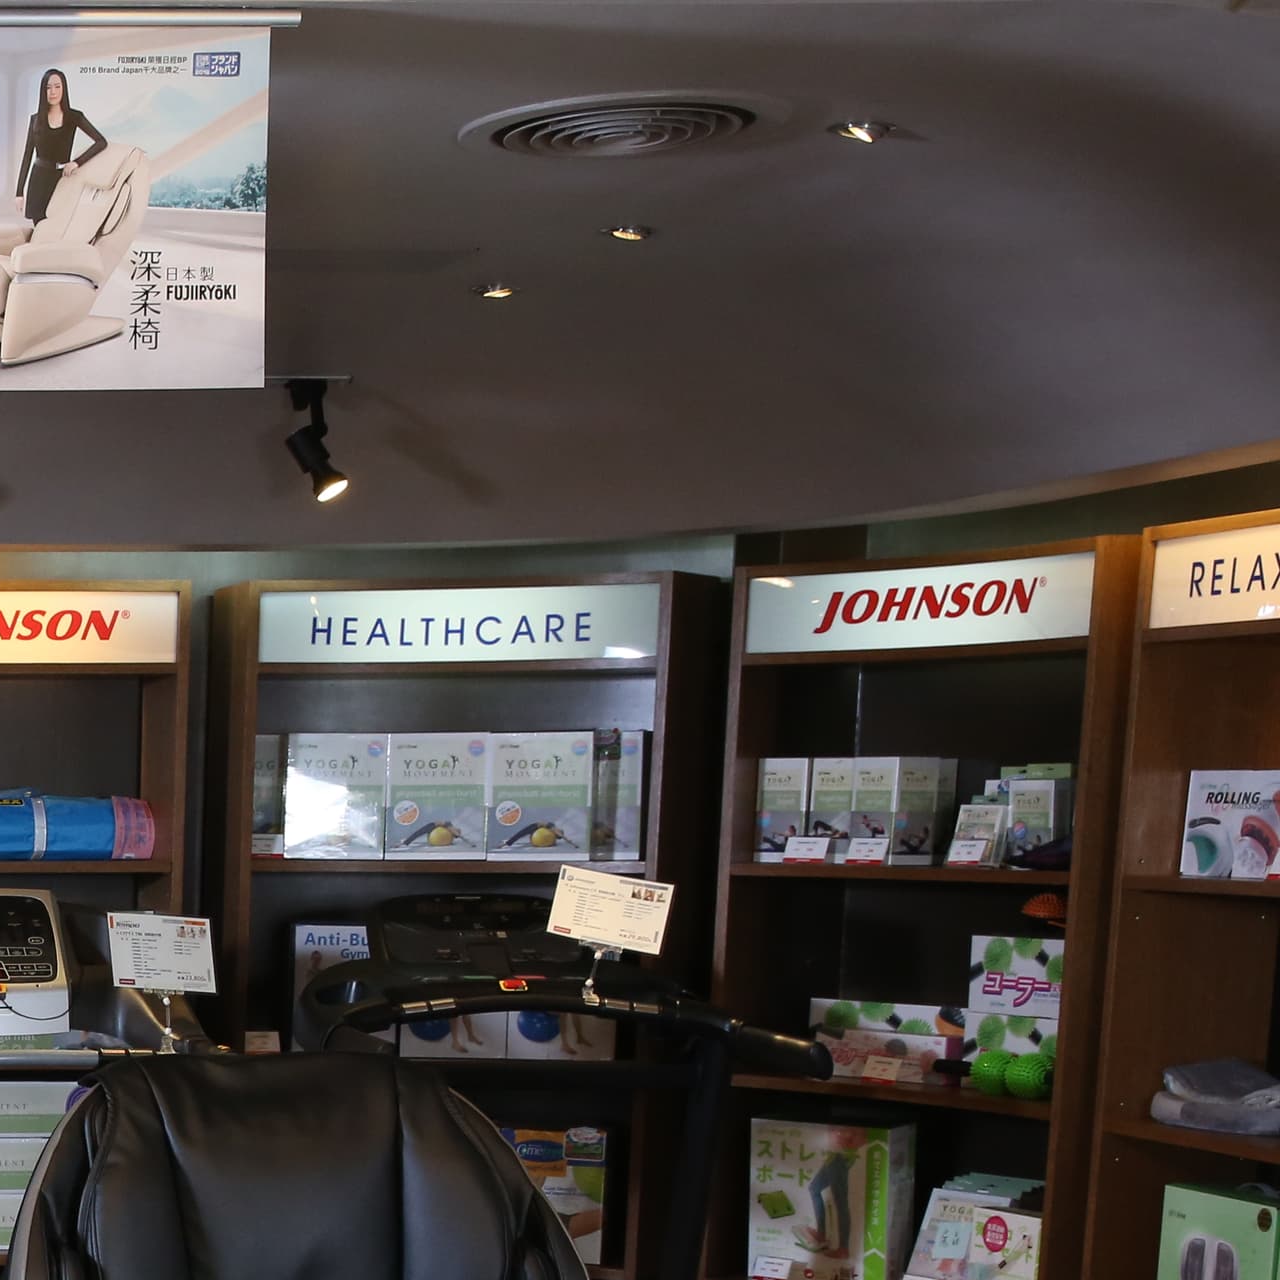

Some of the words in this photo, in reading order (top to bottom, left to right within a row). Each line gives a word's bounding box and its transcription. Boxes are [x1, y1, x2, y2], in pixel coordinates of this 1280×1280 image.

[166, 266, 214, 281] 日本製
[129, 250, 162, 350] 深柔椅
[813, 577, 1040, 635] JOHNSON
[311, 611, 592, 647] HEALTHCARE
[304, 759, 350, 769] YOGA
[403, 759, 450, 769] YOGA
[506, 759, 554, 769] YOGA
[1205, 791, 1261, 805] ROLLING
